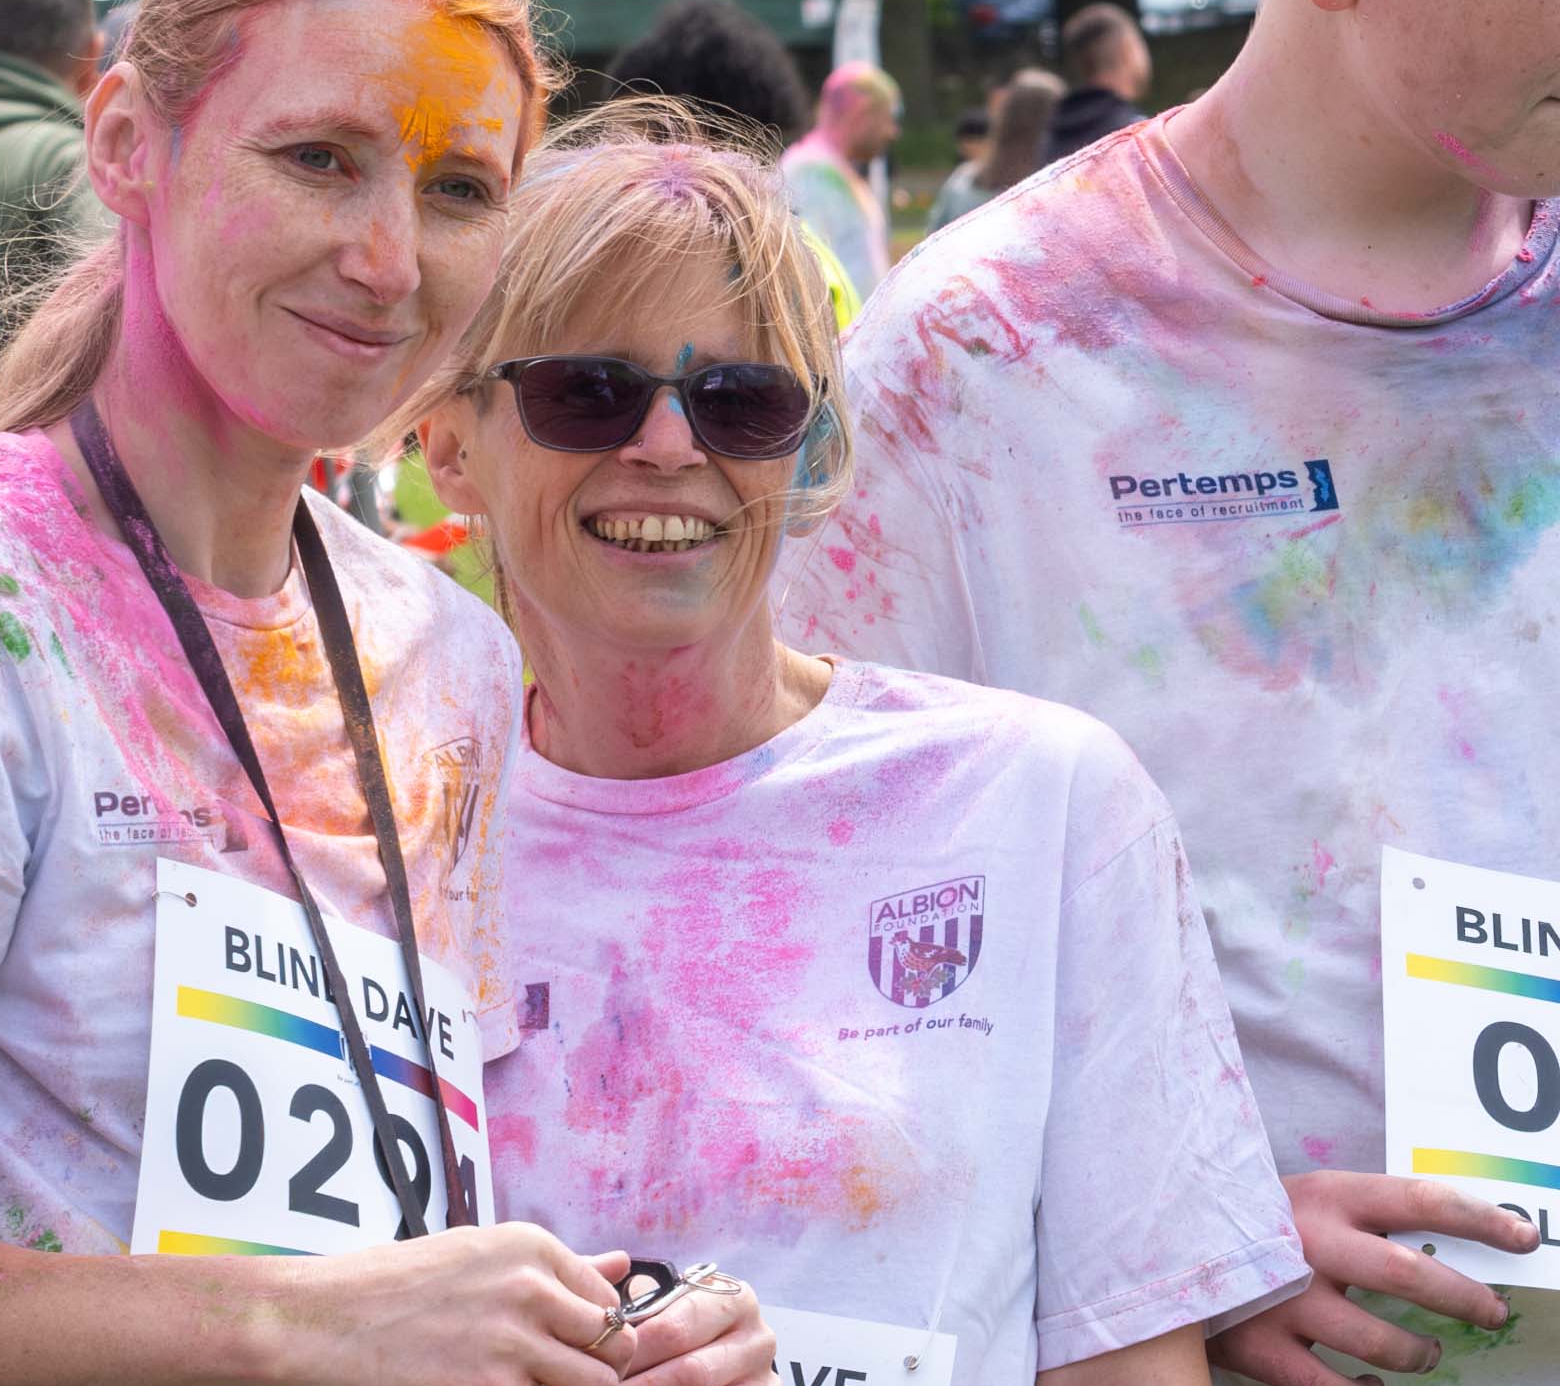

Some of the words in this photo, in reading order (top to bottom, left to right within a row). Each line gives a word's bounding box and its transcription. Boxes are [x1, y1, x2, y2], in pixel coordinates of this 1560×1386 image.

[1109, 469, 1299, 500] Pertemps
[1118, 510, 1143, 523] the
[1150, 506, 1183, 520] face
[1191, 505, 1206, 518] of
[1213, 498, 1304, 516] recruitment
[128, 827, 155, 840] face
[875, 879, 980, 923] ALBION
[874, 902, 980, 933] FOUNDATION
[225, 925, 336, 1005] BLIN
[838, 1027, 860, 1041] Be
[864, 1024, 900, 1041] part
[904, 1017, 922, 1034] of
[926, 1015, 954, 1030] our
[958, 1013, 994, 1037] family
